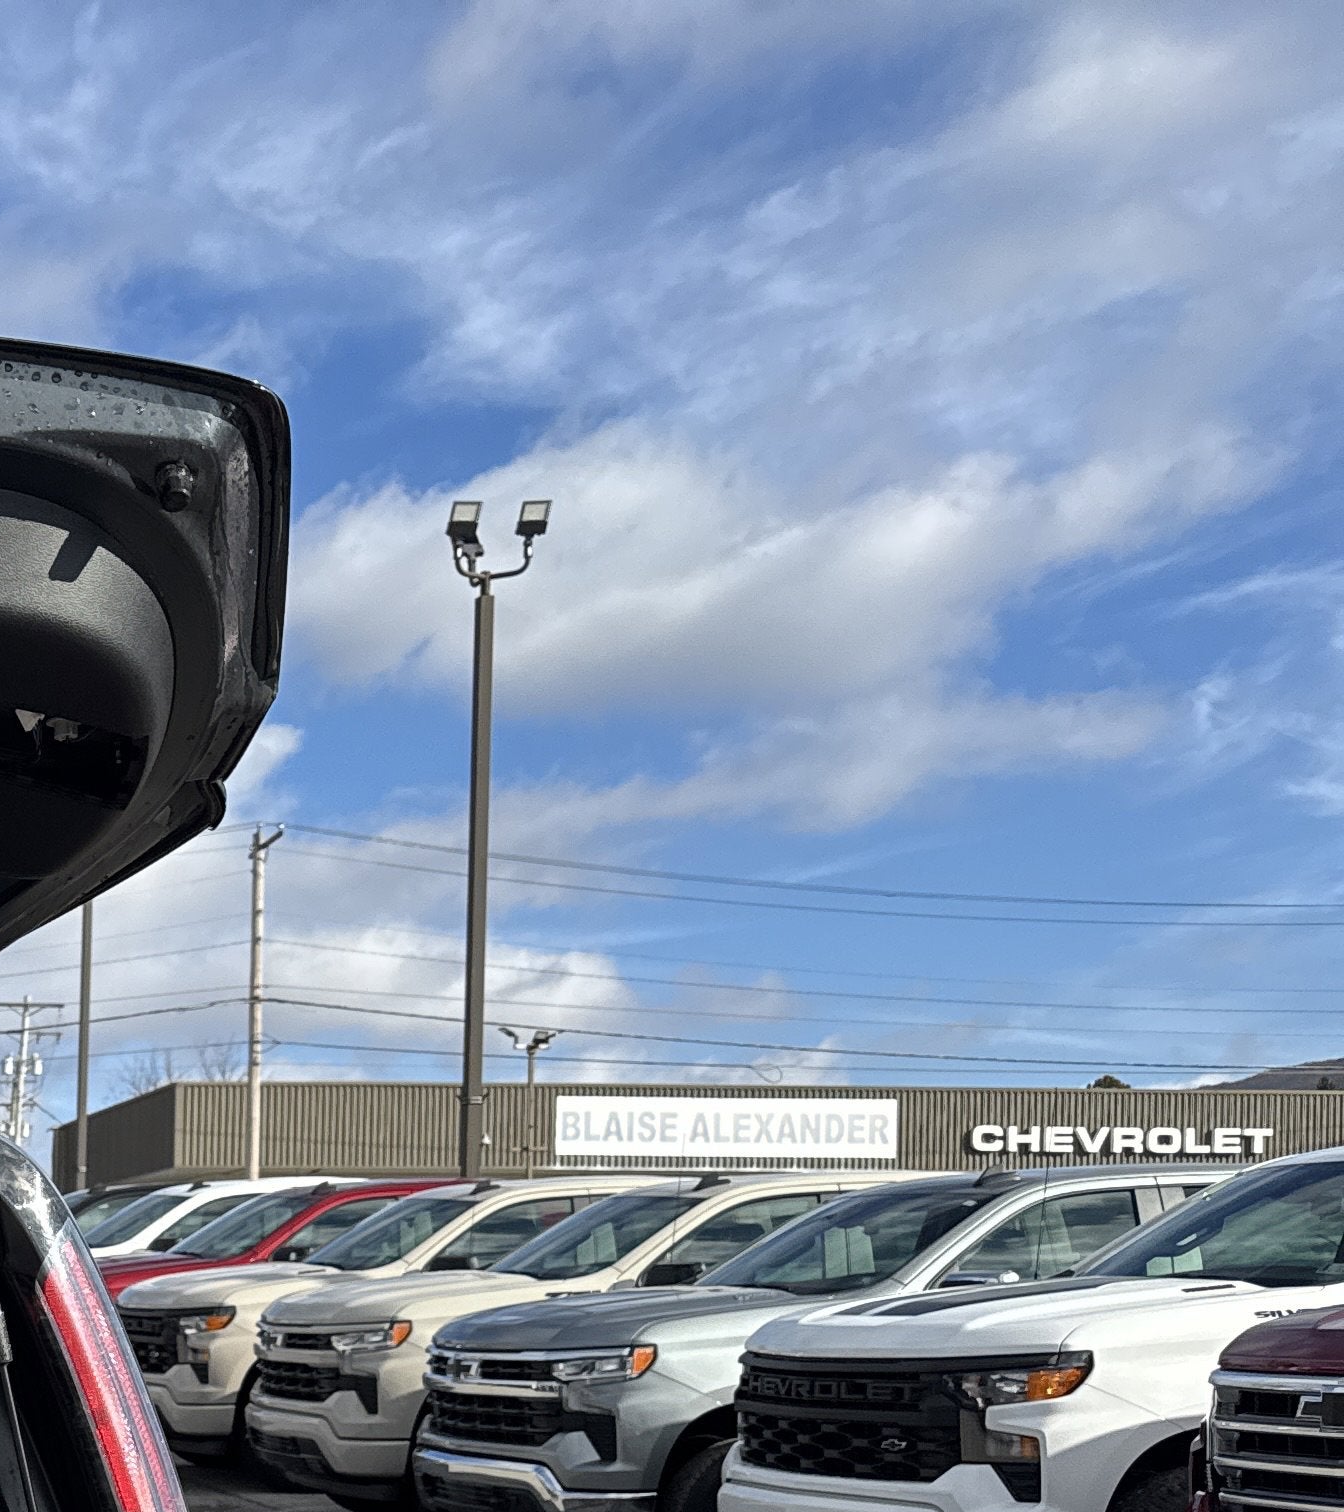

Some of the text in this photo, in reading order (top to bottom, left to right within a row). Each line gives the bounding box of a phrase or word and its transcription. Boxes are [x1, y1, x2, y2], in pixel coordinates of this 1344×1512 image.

[560, 1110, 890, 1145] BLAISE ALEXANDER
[971, 1124, 1274, 1154] CHEVROLET
